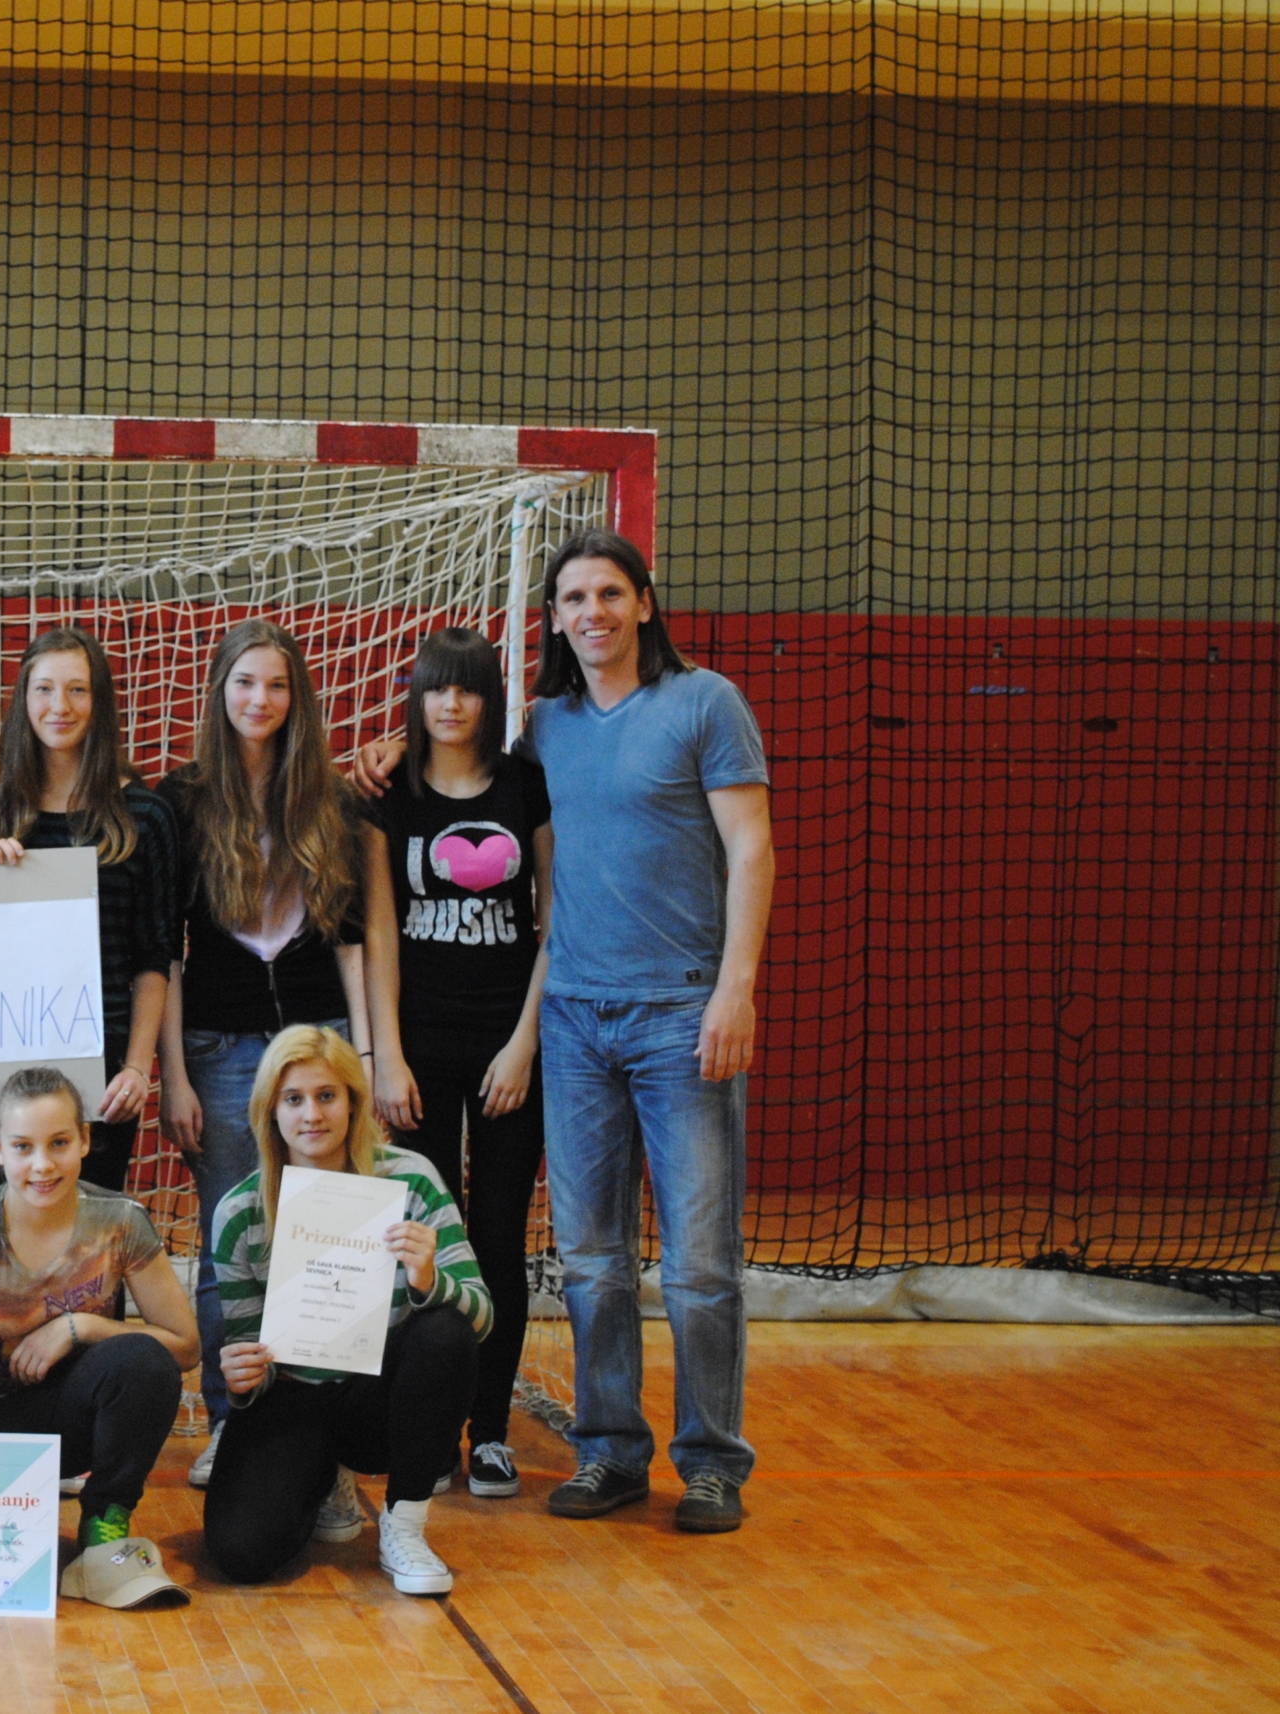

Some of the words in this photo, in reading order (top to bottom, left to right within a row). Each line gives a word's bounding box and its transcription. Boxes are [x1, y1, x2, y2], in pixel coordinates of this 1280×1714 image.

[406, 835, 426, 896] I
[402, 897, 518, 946] MUSIC
[290, 1223, 382, 1254] Priznanje
[305, 1267, 332, 1276] SEVNICA
[316, 1261, 333, 1269] SAVA
[333, 1264, 367, 1273] KLADNIKA
